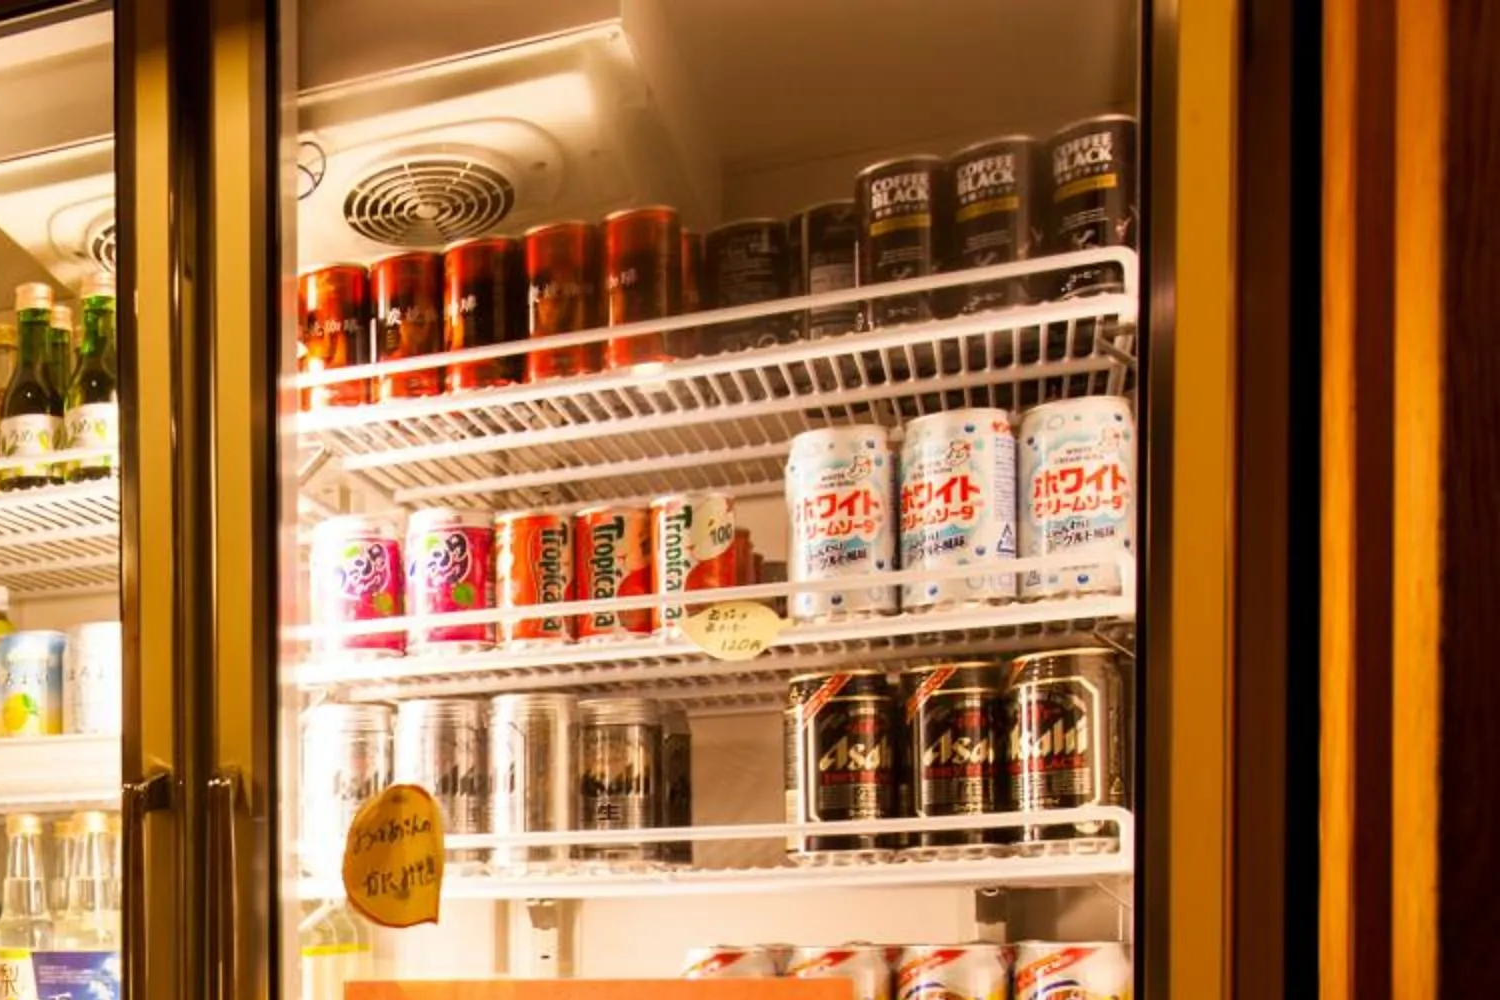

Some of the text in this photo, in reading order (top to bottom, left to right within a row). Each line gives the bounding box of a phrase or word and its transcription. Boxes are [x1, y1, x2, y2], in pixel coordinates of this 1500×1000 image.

[1053, 130, 1113, 157] COFFEE
[1054, 146, 1114, 174] BLACK
[871, 171, 929, 194] COFFEE
[957, 153, 1015, 178] COFFEE
[957, 169, 1015, 196] BLACK
[871, 186, 929, 210] BLACK
[901, 474, 981, 514] ホワイト
[1034, 464, 1128, 498] ホワイト
[540, 522, 568, 631] Tropicaa
[591, 516, 625, 628] Tropicaa
[664, 504, 693, 620] Tropicaa
[818, 734, 893, 773] Asa
[922, 728, 995, 768] Asa
